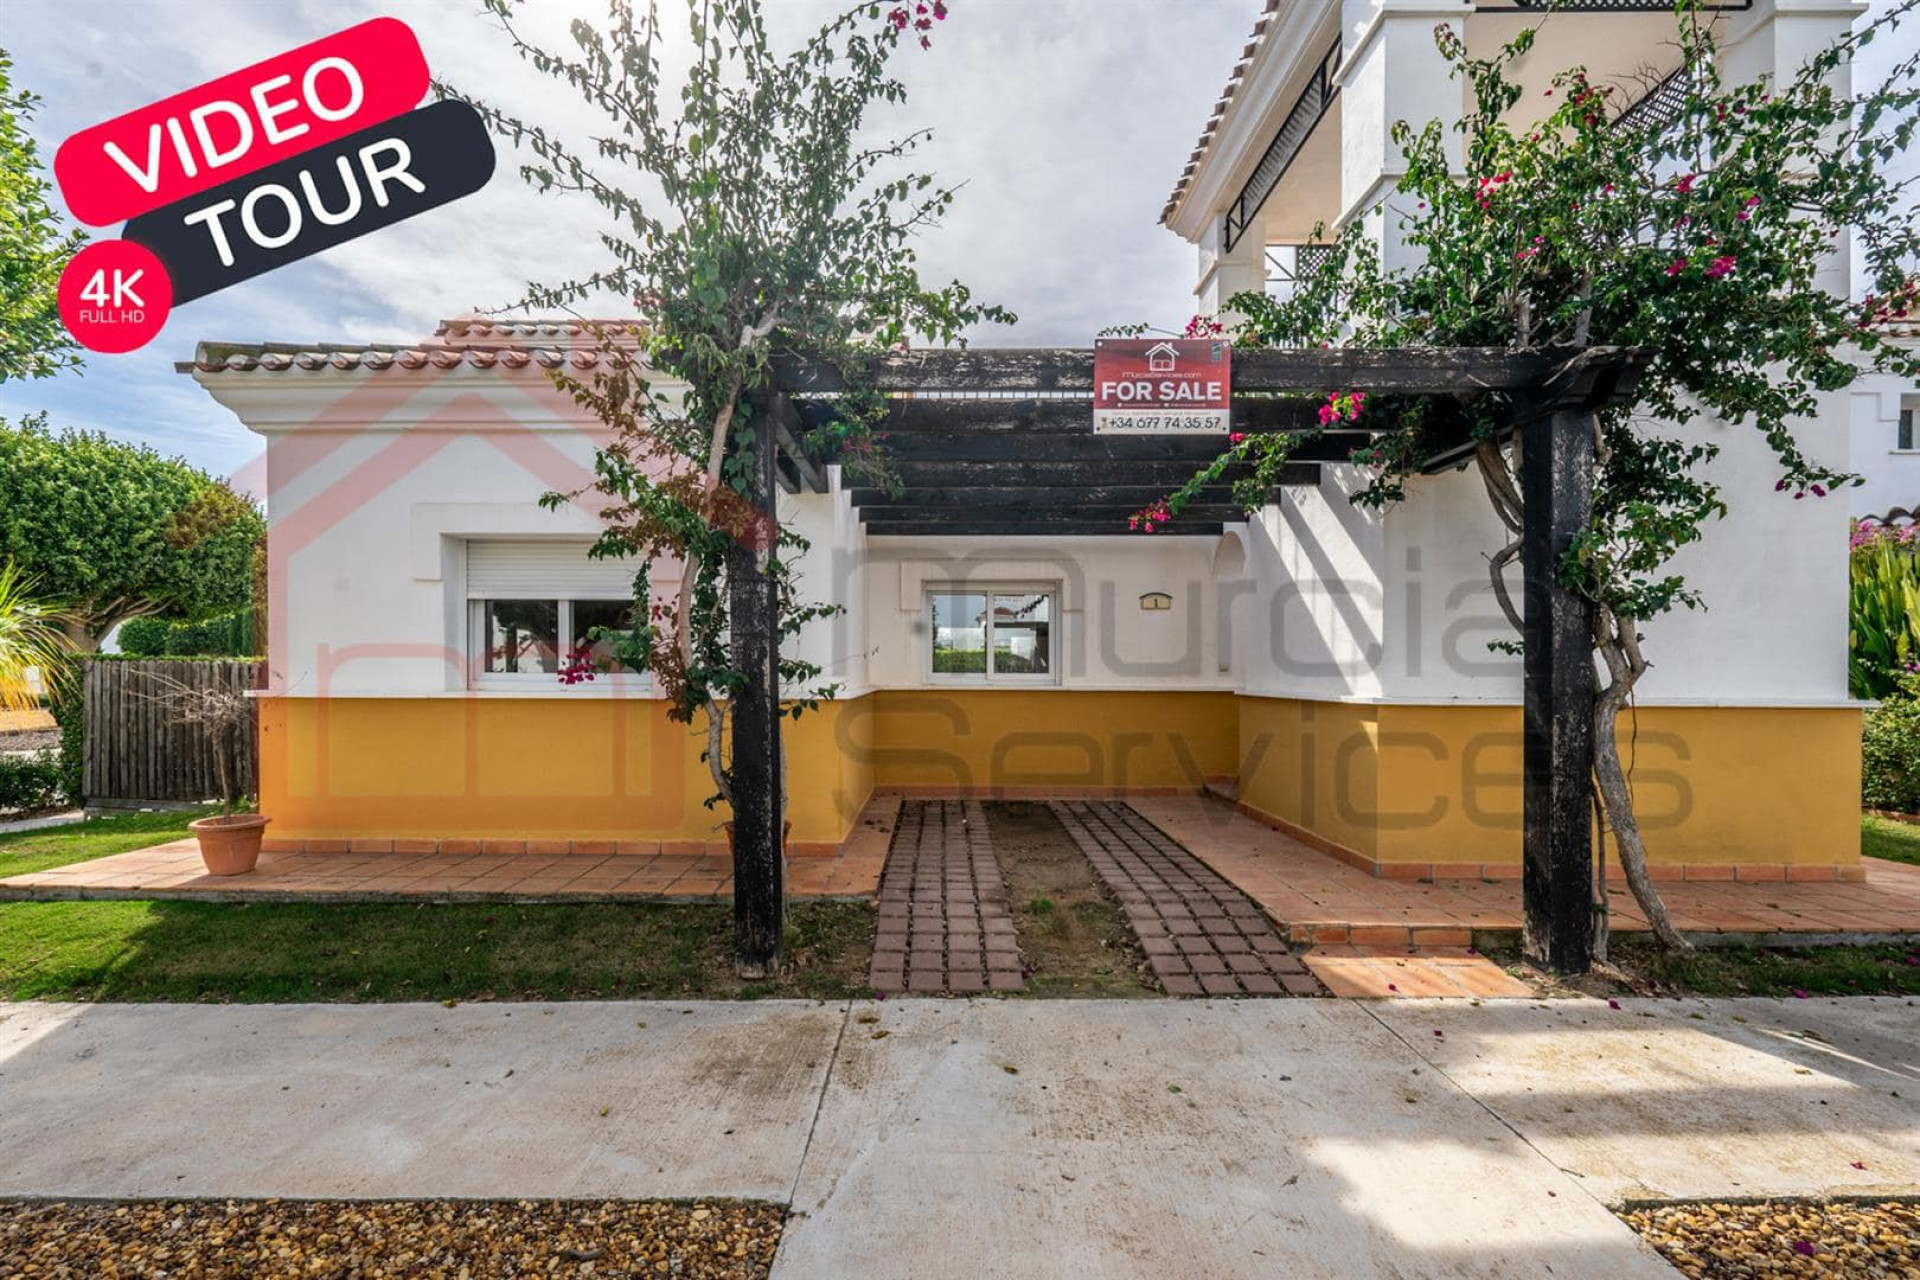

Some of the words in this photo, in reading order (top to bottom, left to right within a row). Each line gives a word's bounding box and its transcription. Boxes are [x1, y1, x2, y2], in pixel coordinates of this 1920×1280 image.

[1101, 381, 1153, 401] FOR
[1158, 381, 1222, 401] SALE
[1109, 417, 1133, 429] +34
[1136, 417, 1160, 429] 677
[1163, 417, 1180, 429] 74
[1184, 417, 1201, 429] 35
[1205, 417, 1222, 429] 57
